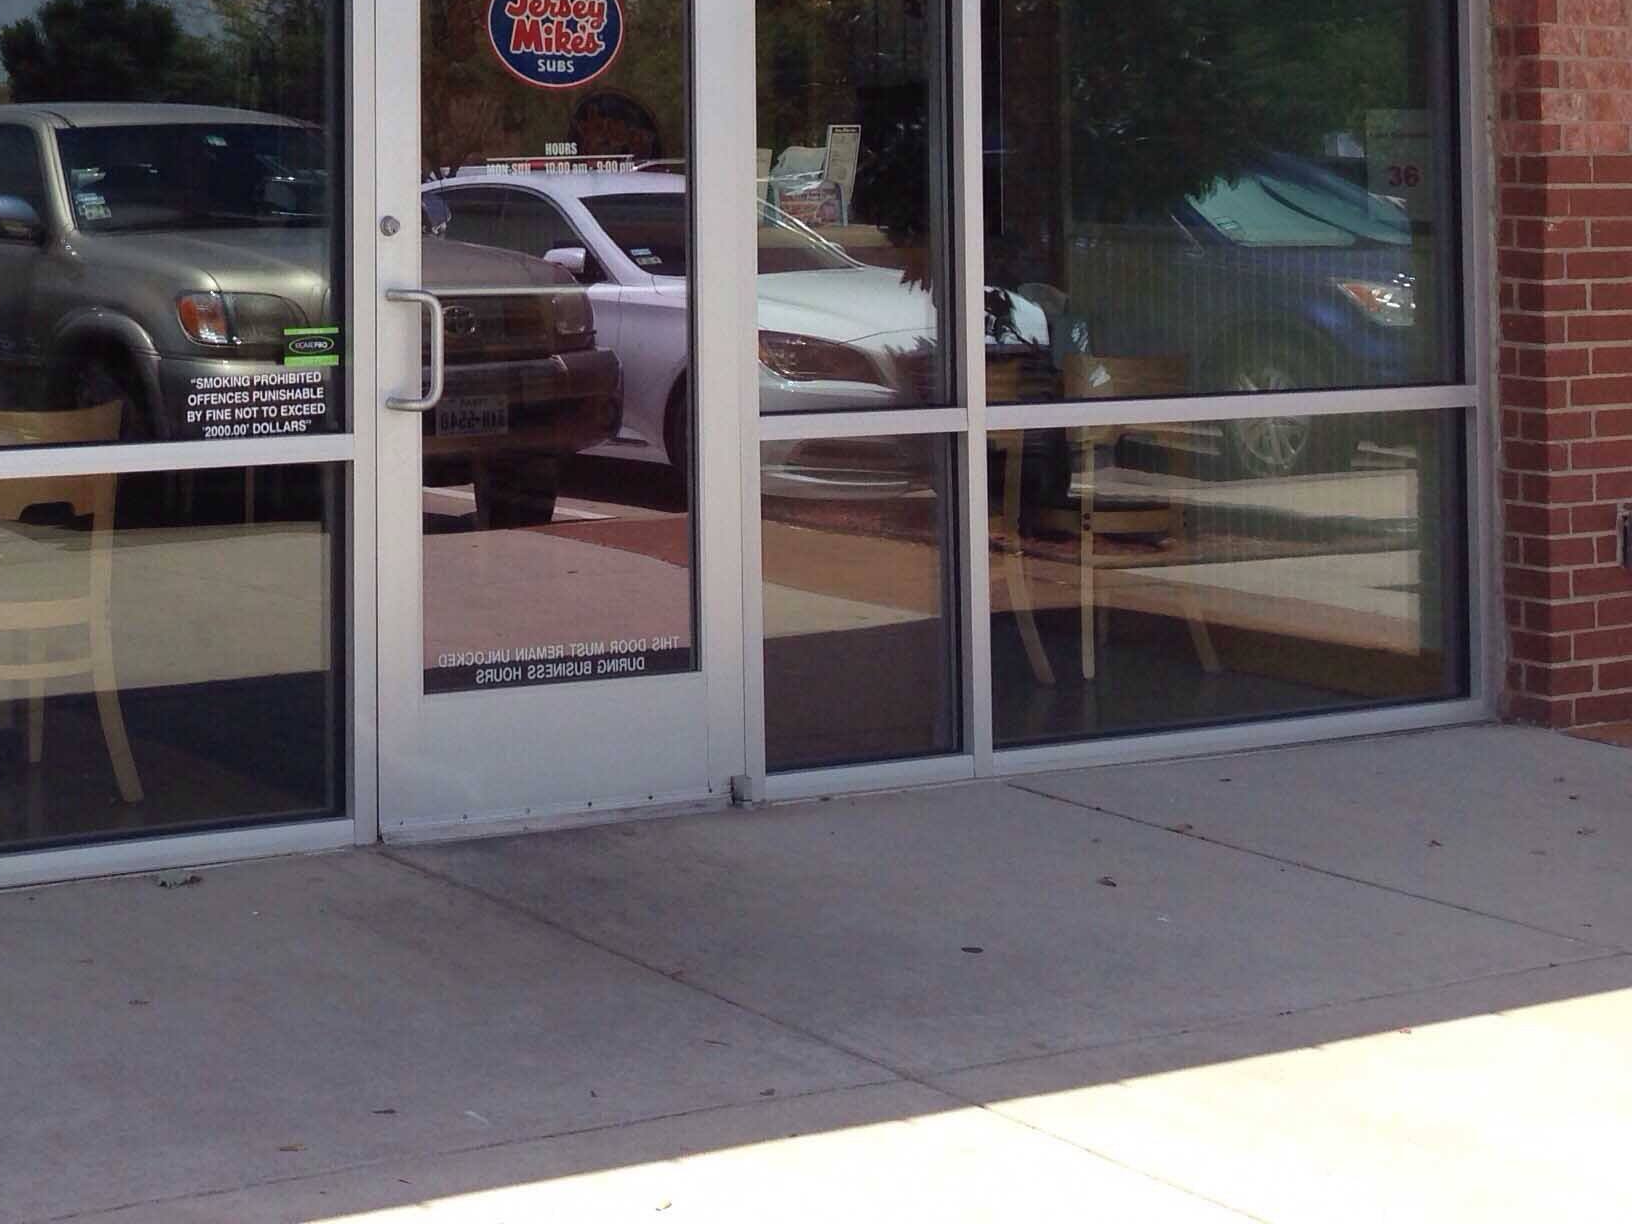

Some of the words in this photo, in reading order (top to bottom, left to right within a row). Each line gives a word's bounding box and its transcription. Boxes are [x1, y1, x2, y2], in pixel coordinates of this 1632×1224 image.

[510, 17, 606, 57] Mike's
[537, 59, 575, 73] SUBS
[545, 142, 578, 156] HOURS
[253, 371, 322, 386] PROHIBITED
[187, 391, 249, 406] OFFENCES
[253, 387, 324, 402] PUNISHABLE
[187, 410, 202, 422] BY
[206, 408, 232, 421] FINE
[235, 407, 258, 420] NOT
[261, 405, 277, 417] TO
[281, 403, 326, 416] EXCEED
